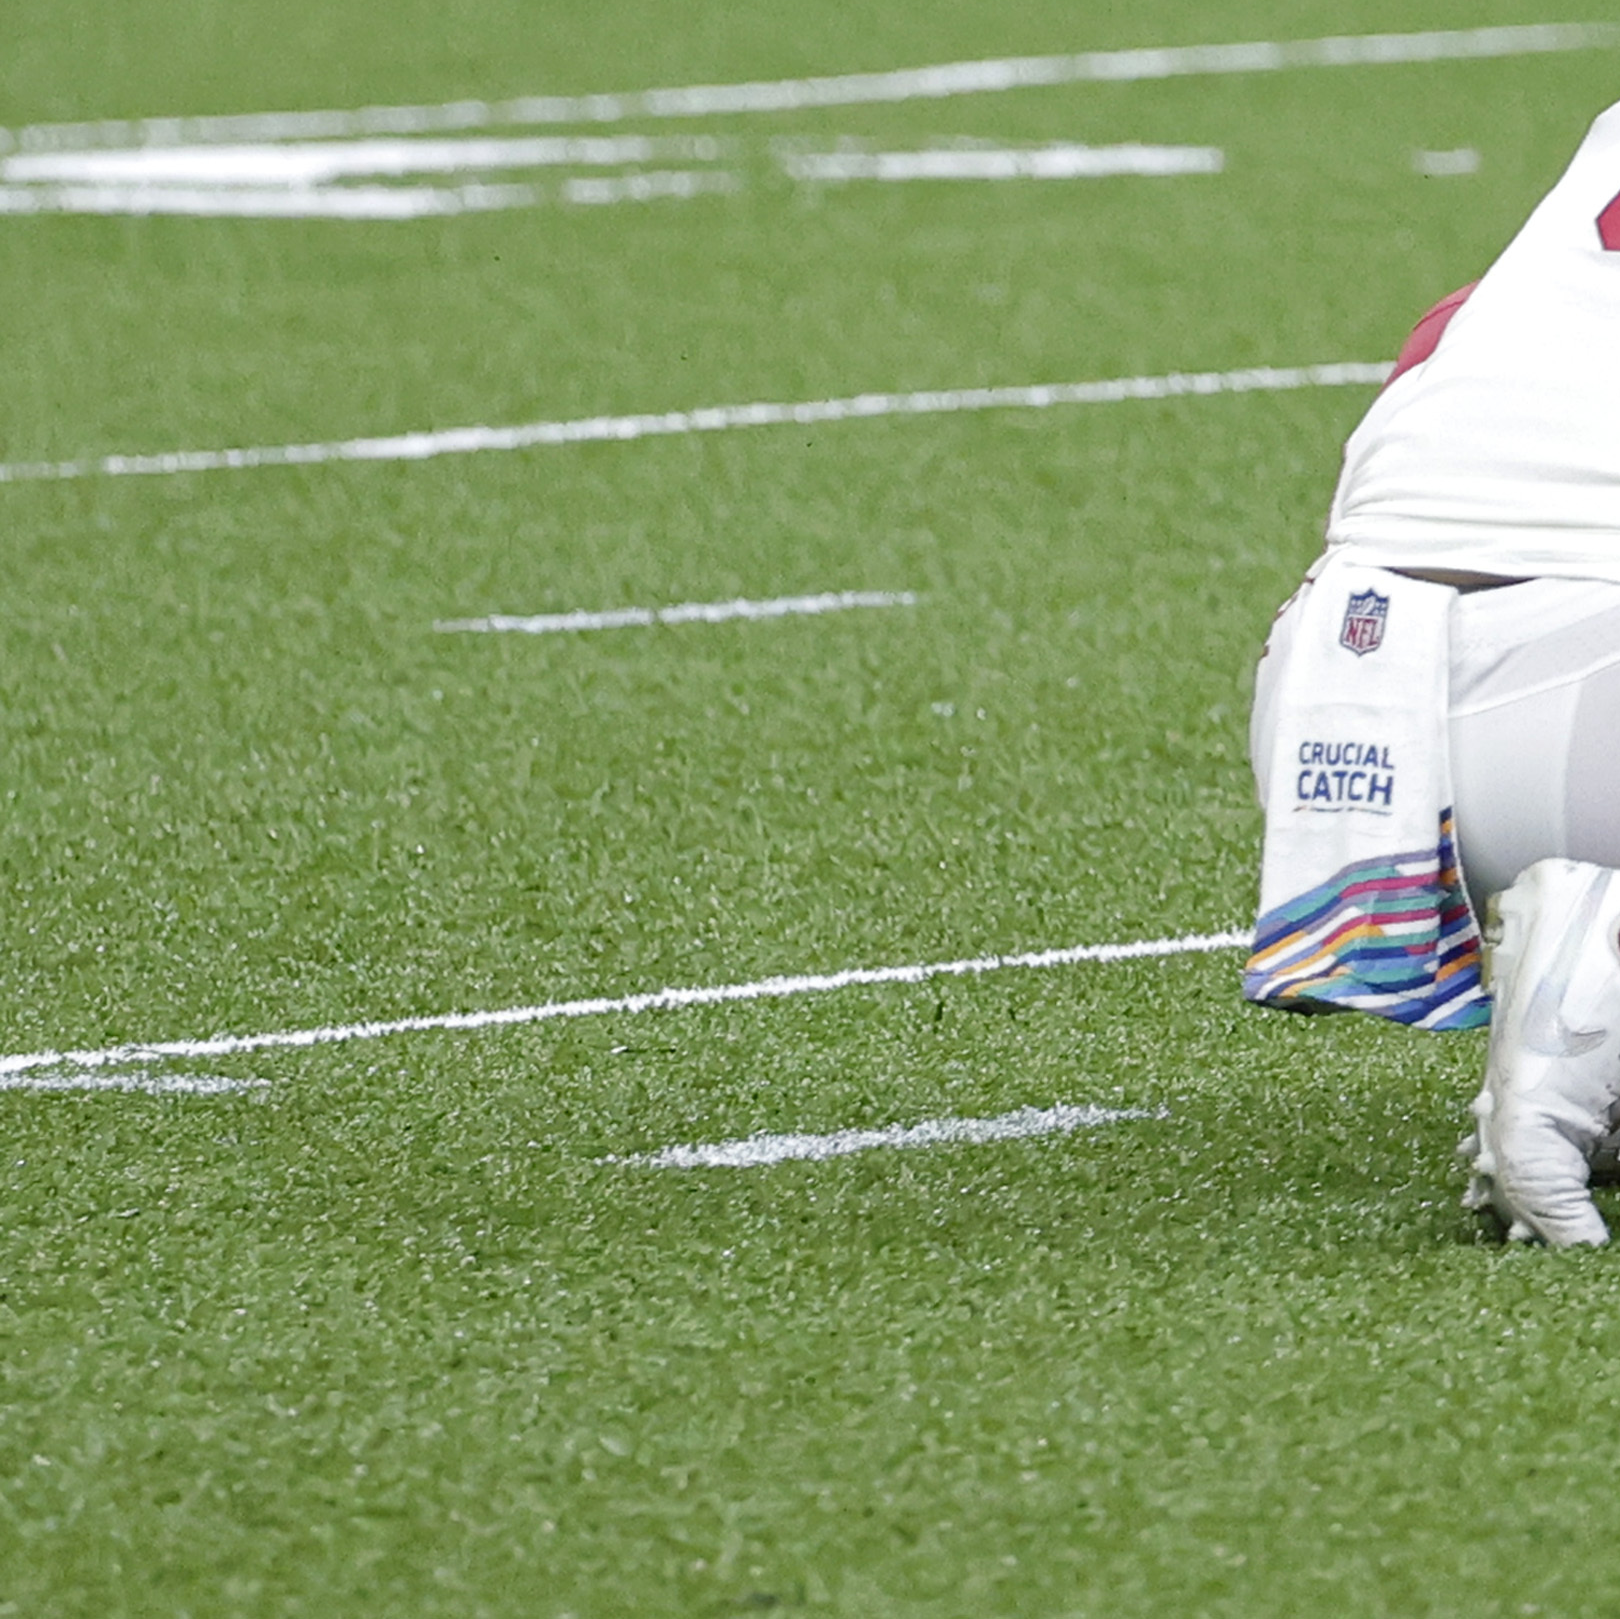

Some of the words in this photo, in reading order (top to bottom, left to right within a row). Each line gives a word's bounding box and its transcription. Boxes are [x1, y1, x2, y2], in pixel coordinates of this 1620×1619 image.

[1344, 615, 1382, 650] NFL
[1298, 740, 1395, 770] CRUCIAL
[1297, 769, 1394, 806] CATCH
